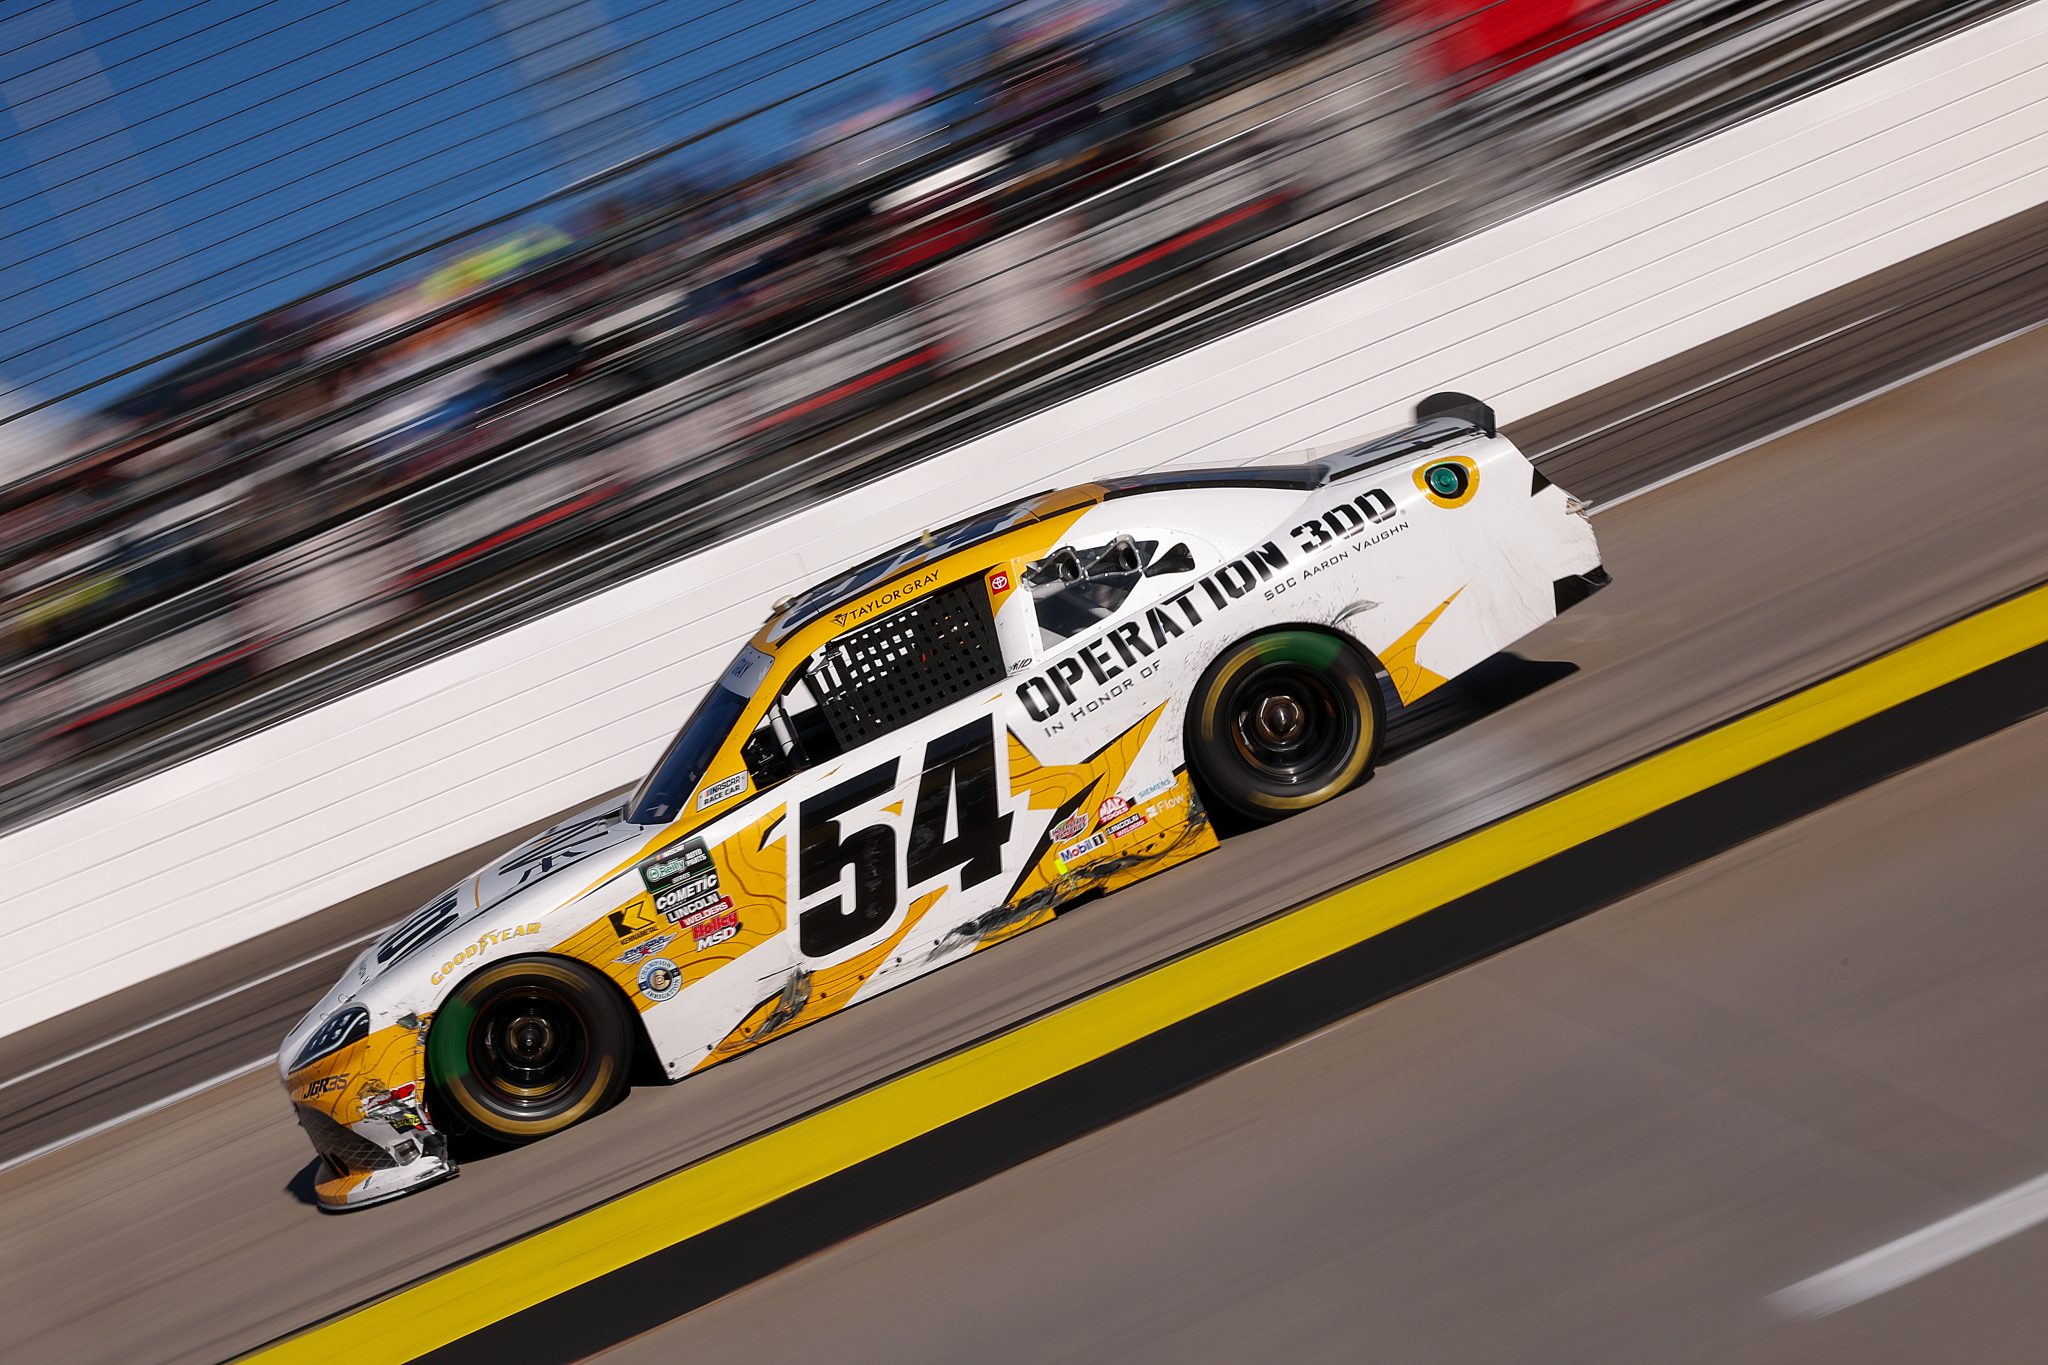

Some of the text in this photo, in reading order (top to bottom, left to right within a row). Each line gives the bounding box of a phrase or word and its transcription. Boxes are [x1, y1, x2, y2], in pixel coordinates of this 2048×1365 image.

[1303, 552, 1349, 580] AARON
[1352, 521, 1409, 552] VAUGHN
[849, 569, 939, 619] TAYLOR GRAY
[1015, 541, 1289, 722] OPERATION
[1045, 659, 1161, 737] IN HONOR OF
[704, 784, 740, 805] RACE CAR
[712, 775, 741, 793] NASCAR
[1139, 777, 1172, 798] SIEMENS
[1157, 794, 1185, 814] Flow
[799, 712, 1015, 958] 54
[1106, 814, 1139, 835] LINCOLN
[1060, 832, 1105, 861] Mobil 1
[656, 873, 717, 910] COMETIC
[668, 892, 720, 922] LINCOLN
[682, 901, 729, 926] WELDERS
[691, 911, 740, 942] Holley
[697, 926, 739, 953] MSD
[431, 922, 541, 985] GOODYEAR
[640, 960, 672, 980] CHAMPION
[646, 979, 681, 999] IRRIGATION
